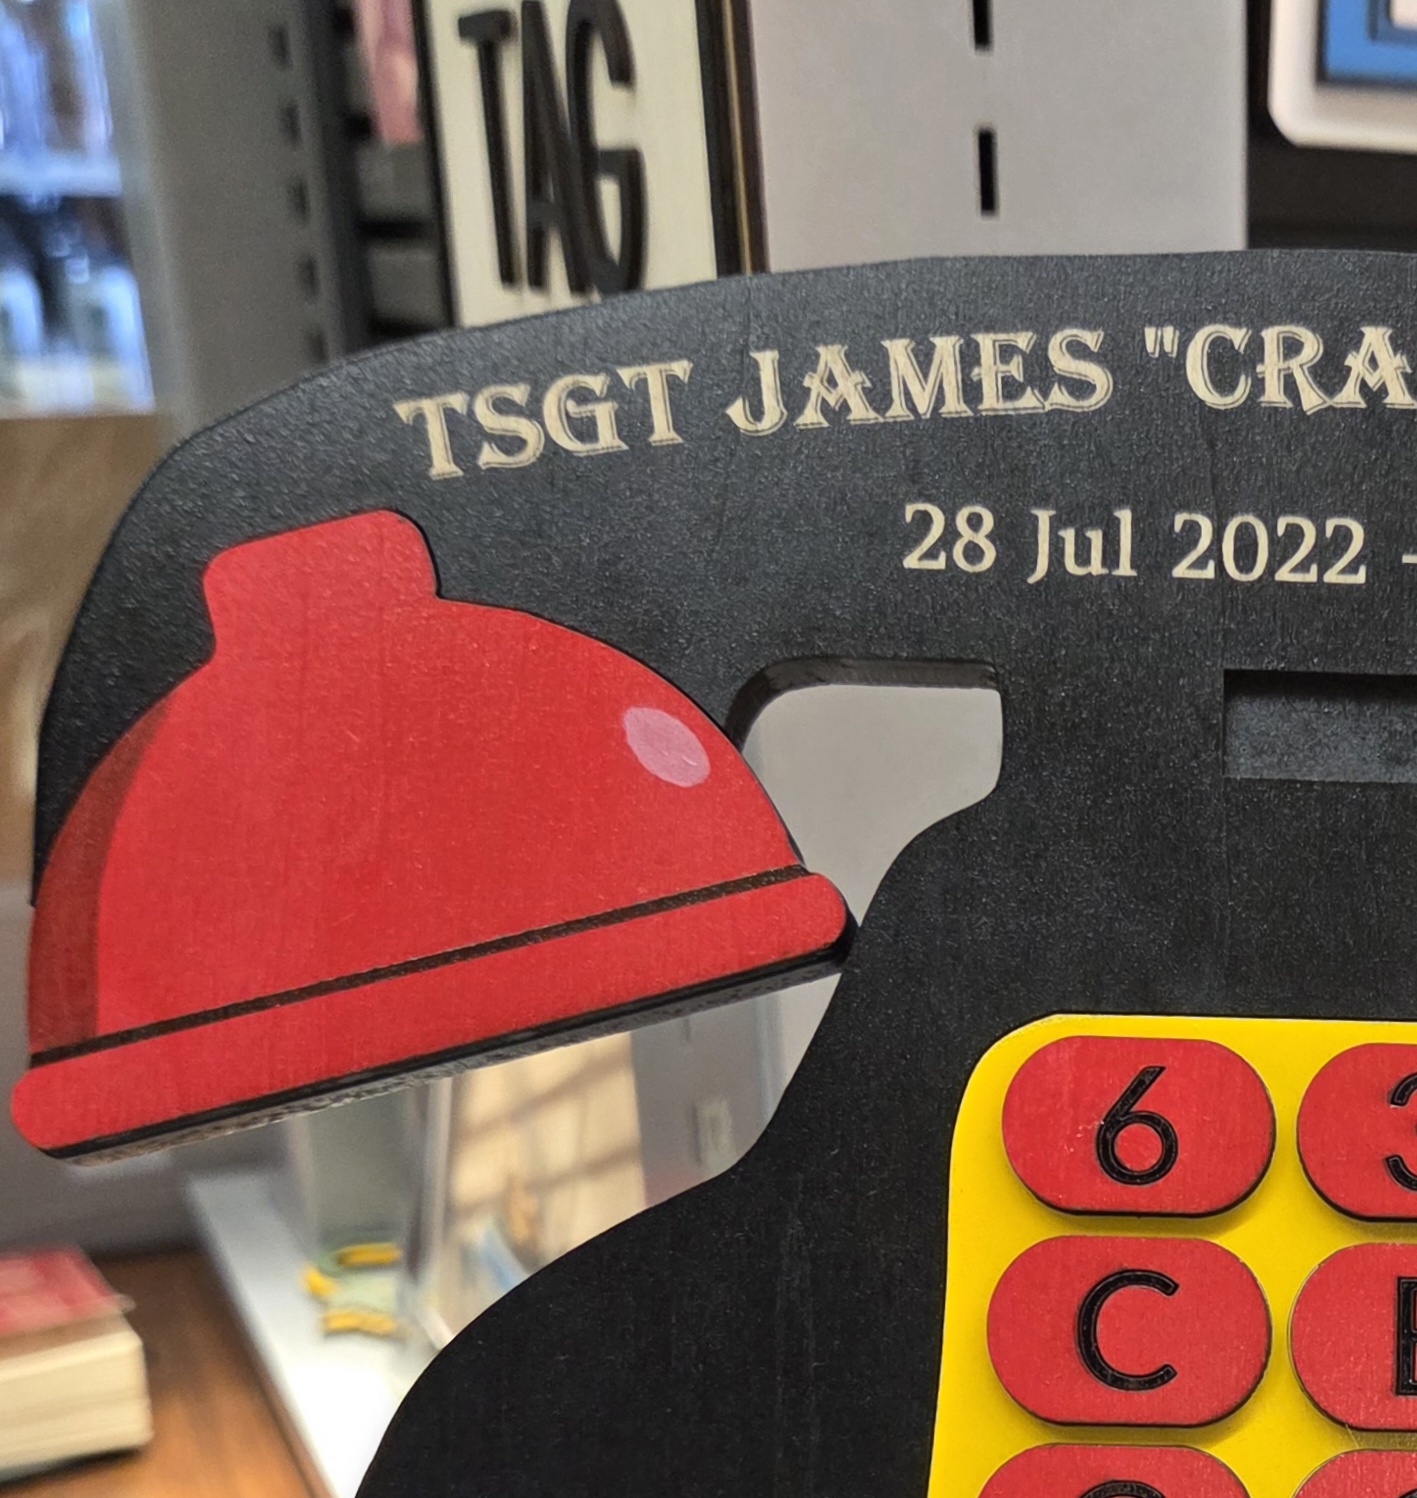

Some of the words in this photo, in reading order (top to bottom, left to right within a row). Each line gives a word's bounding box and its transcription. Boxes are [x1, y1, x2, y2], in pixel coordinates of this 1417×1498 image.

[456, 0, 648, 294] TAG
[392, 360, 694, 480] TSGT
[725, 329, 1114, 436] JAMES
[901, 502, 998, 573] 28
[1026, 508, 1138, 584] Jul
[1171, 511, 1367, 584] 2022
[1094, 1064, 1179, 1186] 6
[1075, 1268, 1180, 1392] C
